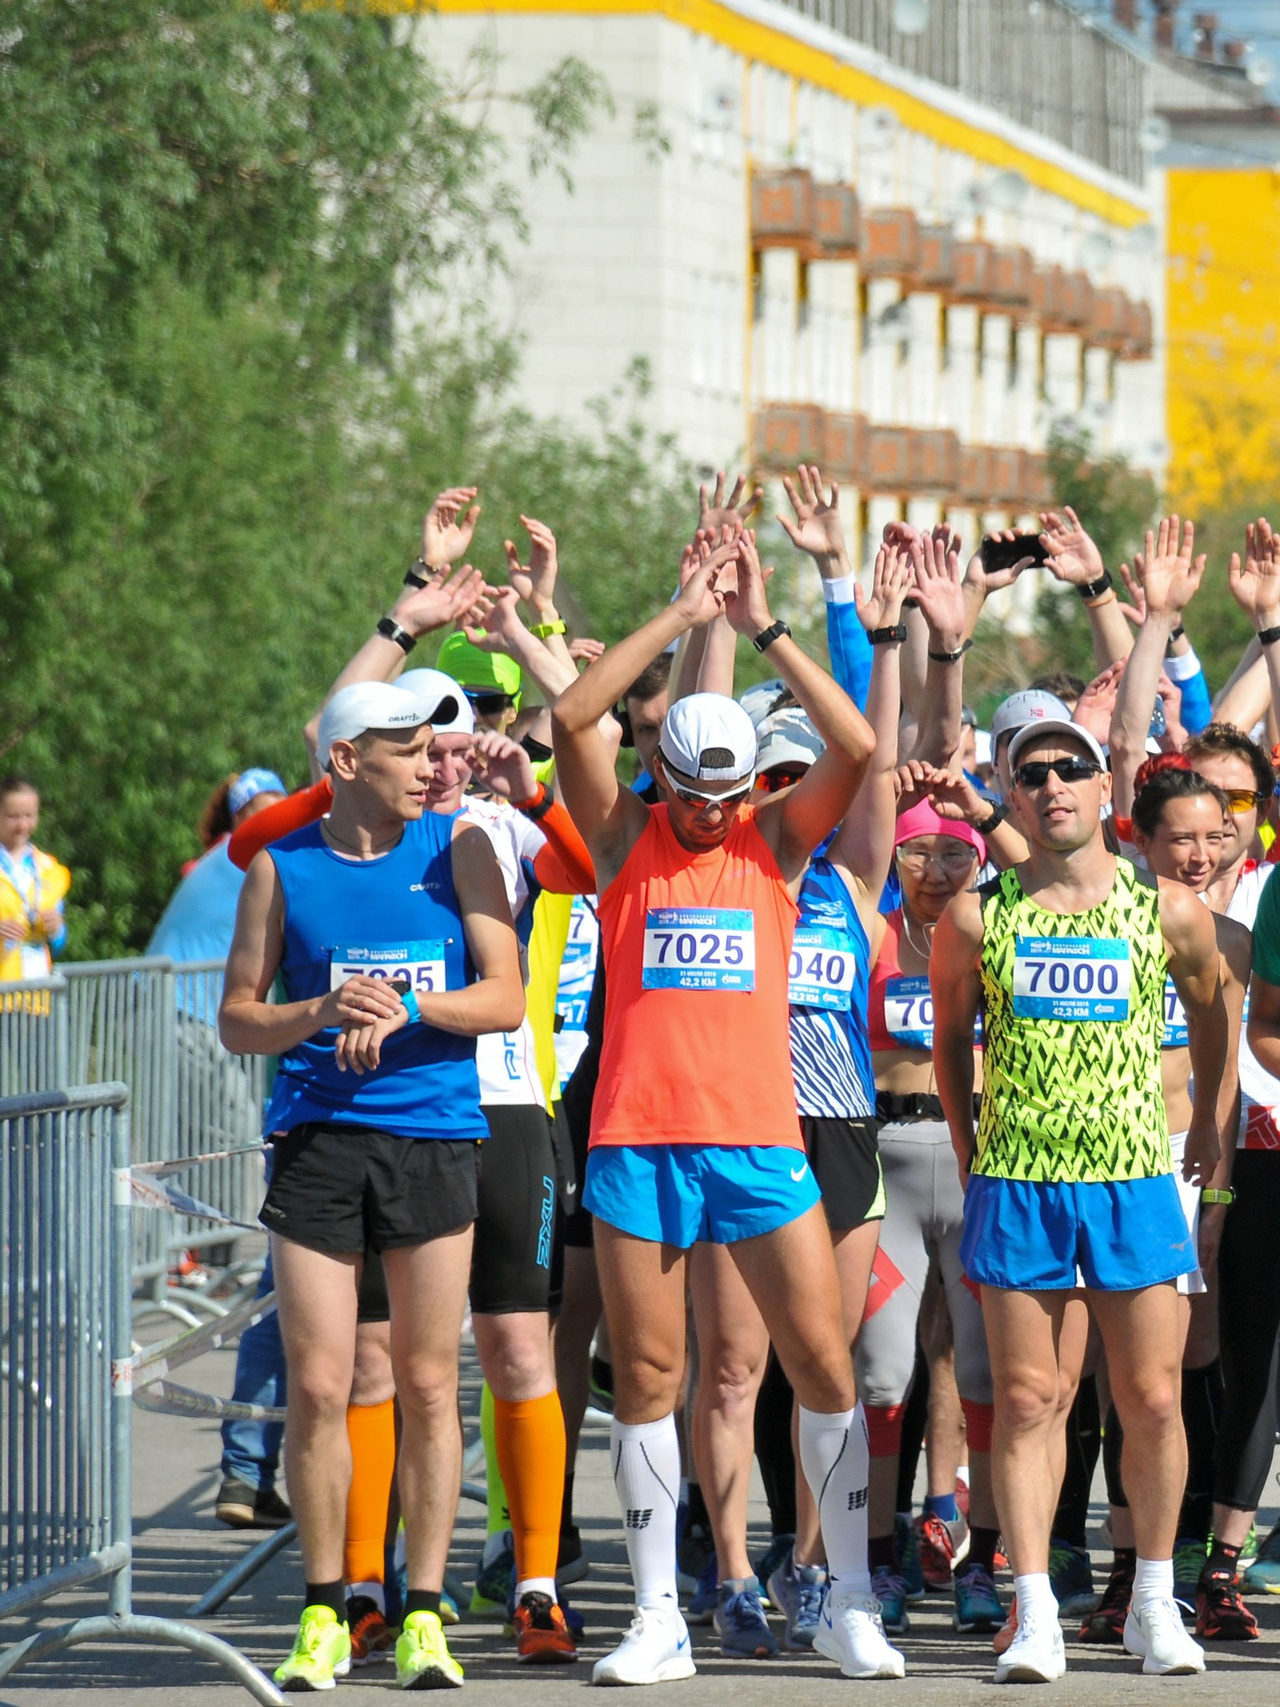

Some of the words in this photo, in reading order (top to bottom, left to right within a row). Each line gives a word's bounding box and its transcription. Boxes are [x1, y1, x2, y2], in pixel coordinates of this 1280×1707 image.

[654, 933, 743, 965] 7025
[680, 977, 700, 987] 42,2
[1025, 962, 1118, 995] 7000
[1052, 1007, 1073, 1018] 42,2
[536, 1176, 555, 1270] 2XU
